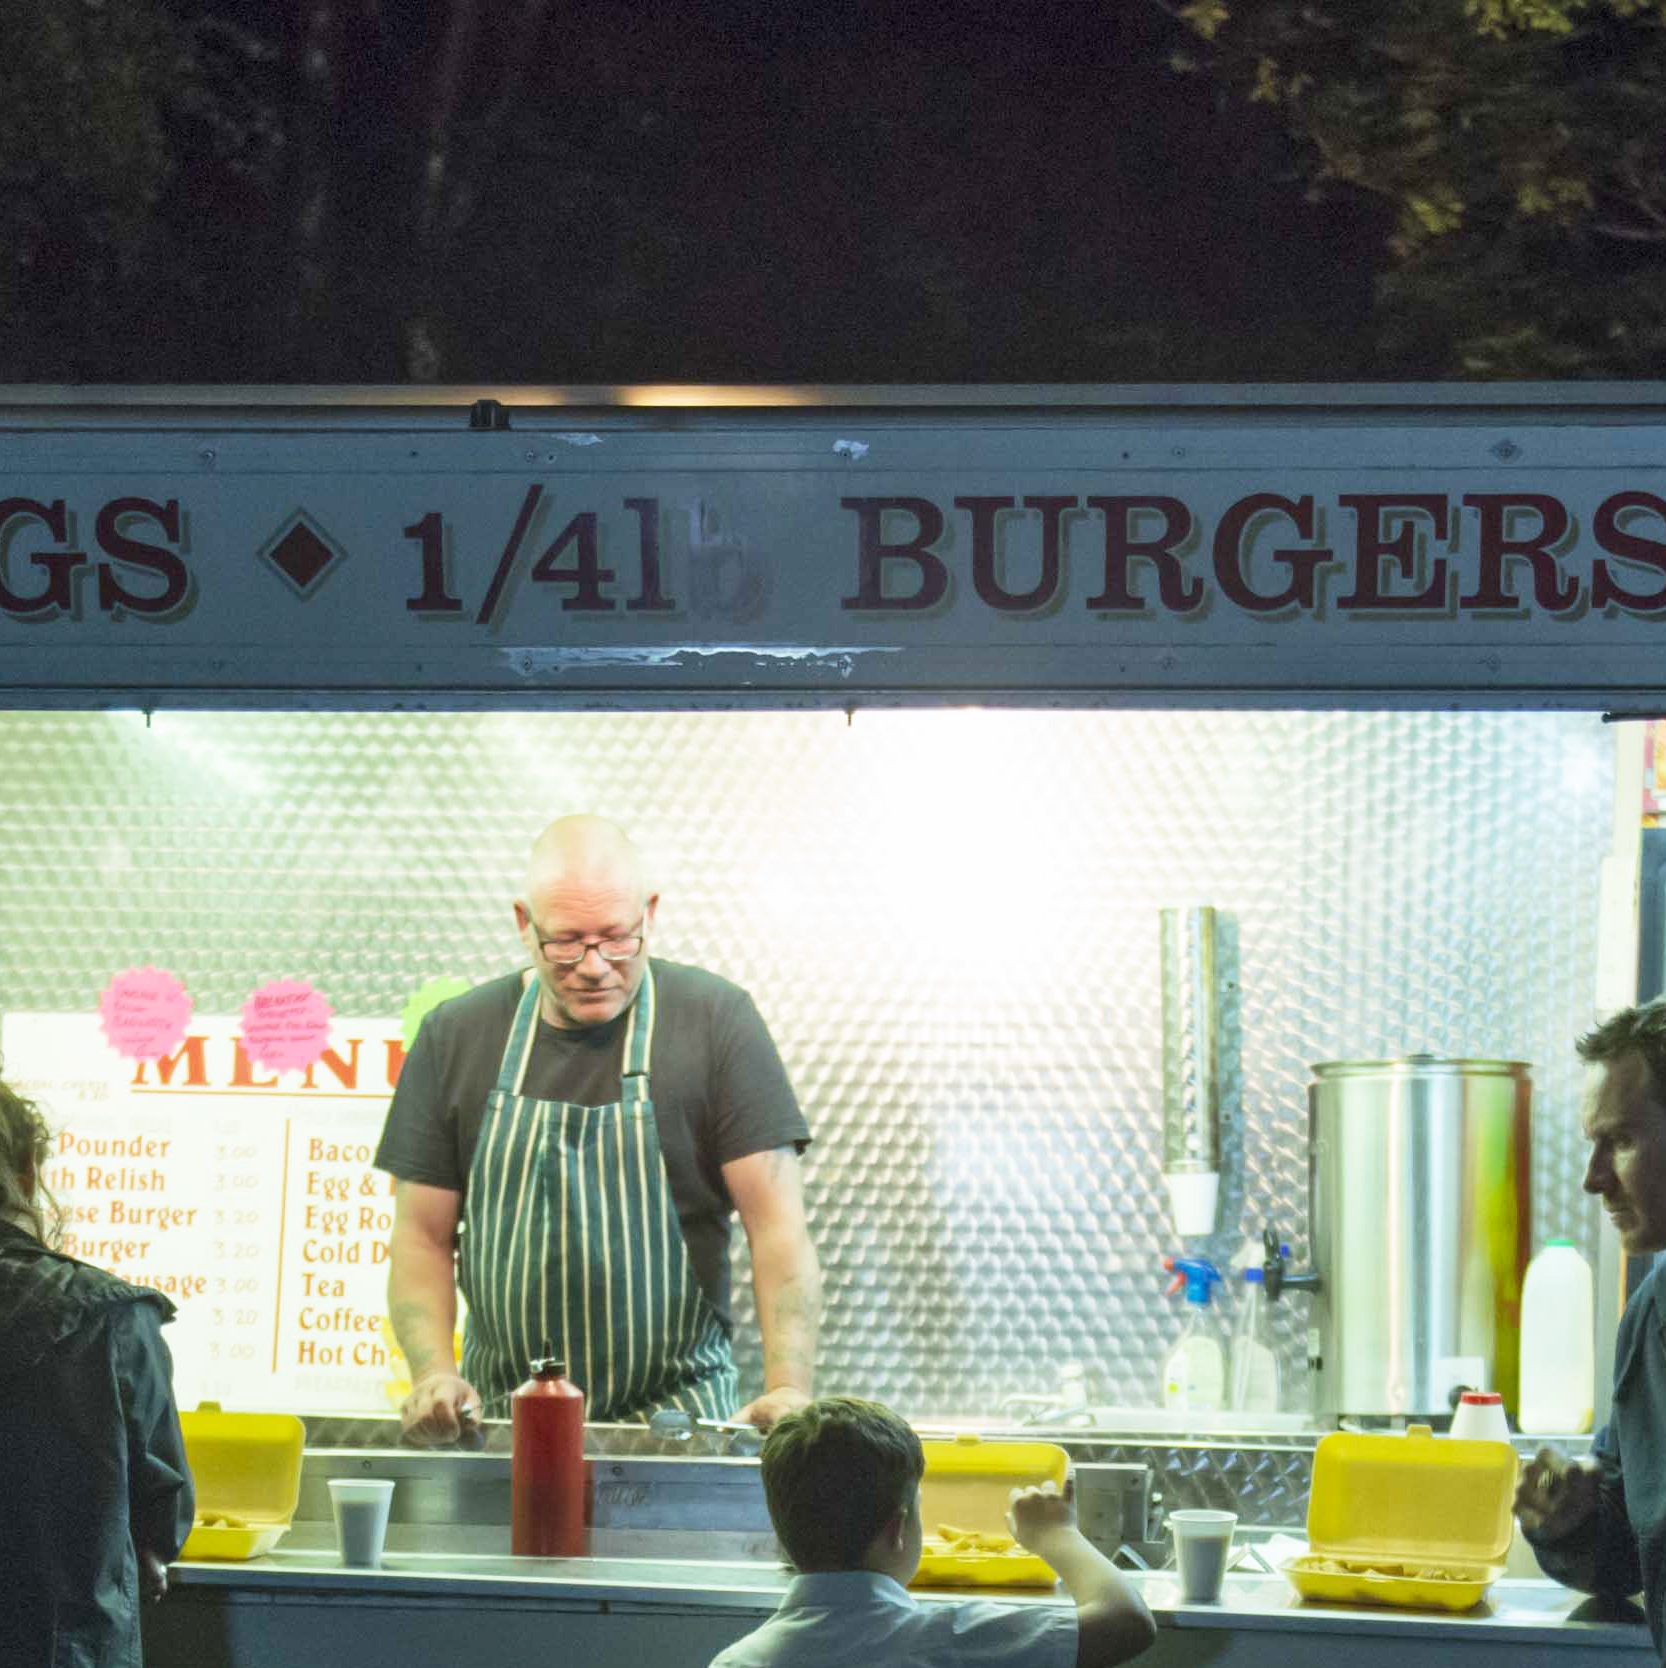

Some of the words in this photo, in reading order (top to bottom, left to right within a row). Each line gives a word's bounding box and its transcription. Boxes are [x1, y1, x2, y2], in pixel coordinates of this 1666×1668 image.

[59, 1131, 172, 1158] Pounder
[86, 1165, 166, 1192] Relish
[305, 1170, 351, 1201] Egg
[357, 1171, 379, 1197] &
[109, 1200, 199, 1231] Burger
[303, 1204, 349, 1235] Egg
[61, 1232, 152, 1264] Burger
[301, 1239, 361, 1266] Cold
[300, 1271, 346, 1298] Tea
[298, 1305, 380, 1333] Coffee
[296, 1339, 345, 1366] Hot
